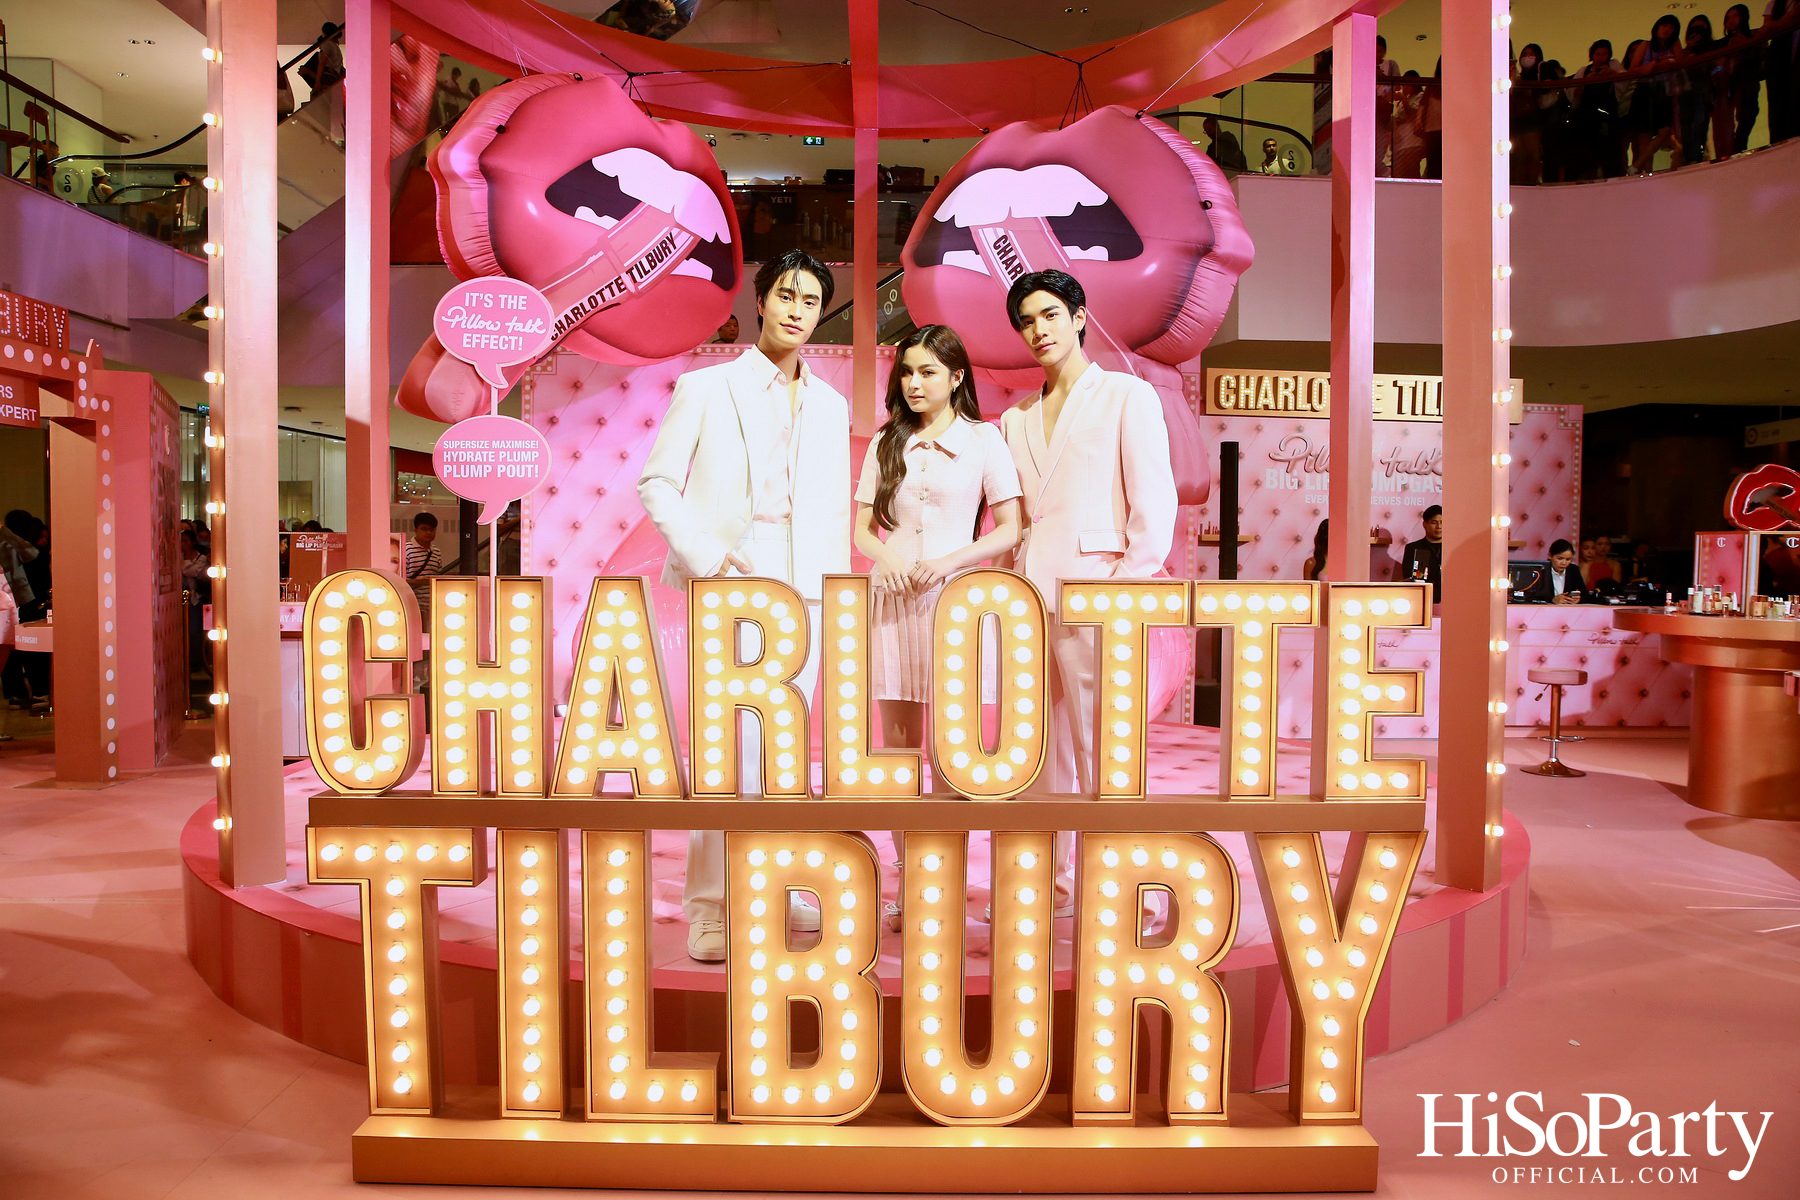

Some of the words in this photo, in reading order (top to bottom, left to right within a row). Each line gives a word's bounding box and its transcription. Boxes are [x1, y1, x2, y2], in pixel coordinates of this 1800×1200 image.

[771, 196, 792, 204] YETI
[625, 232, 677, 284] TILBURY
[993, 234, 1027, 281] CHAR
[499, 294, 528, 310] THE
[441, 306, 501, 329] Pillow
[505, 316, 547, 334] talk
[462, 333, 523, 351] EFFECT!
[443, 440, 490, 449] SUPERSIZE
[492, 440, 539, 449] MAXIMISE!
[443, 451, 496, 463] HYDRATE
[500, 451, 540, 463] PLUMP
[443, 464, 493, 478] PLUMP
[497, 464, 539, 478] POUT!
[1265, 468, 1299, 490] BIG
[1404, 496, 1425, 506] ONE!
[302, 571, 1431, 800] CHARLOTTE
[305, 826, 1429, 1126] TILBURY
